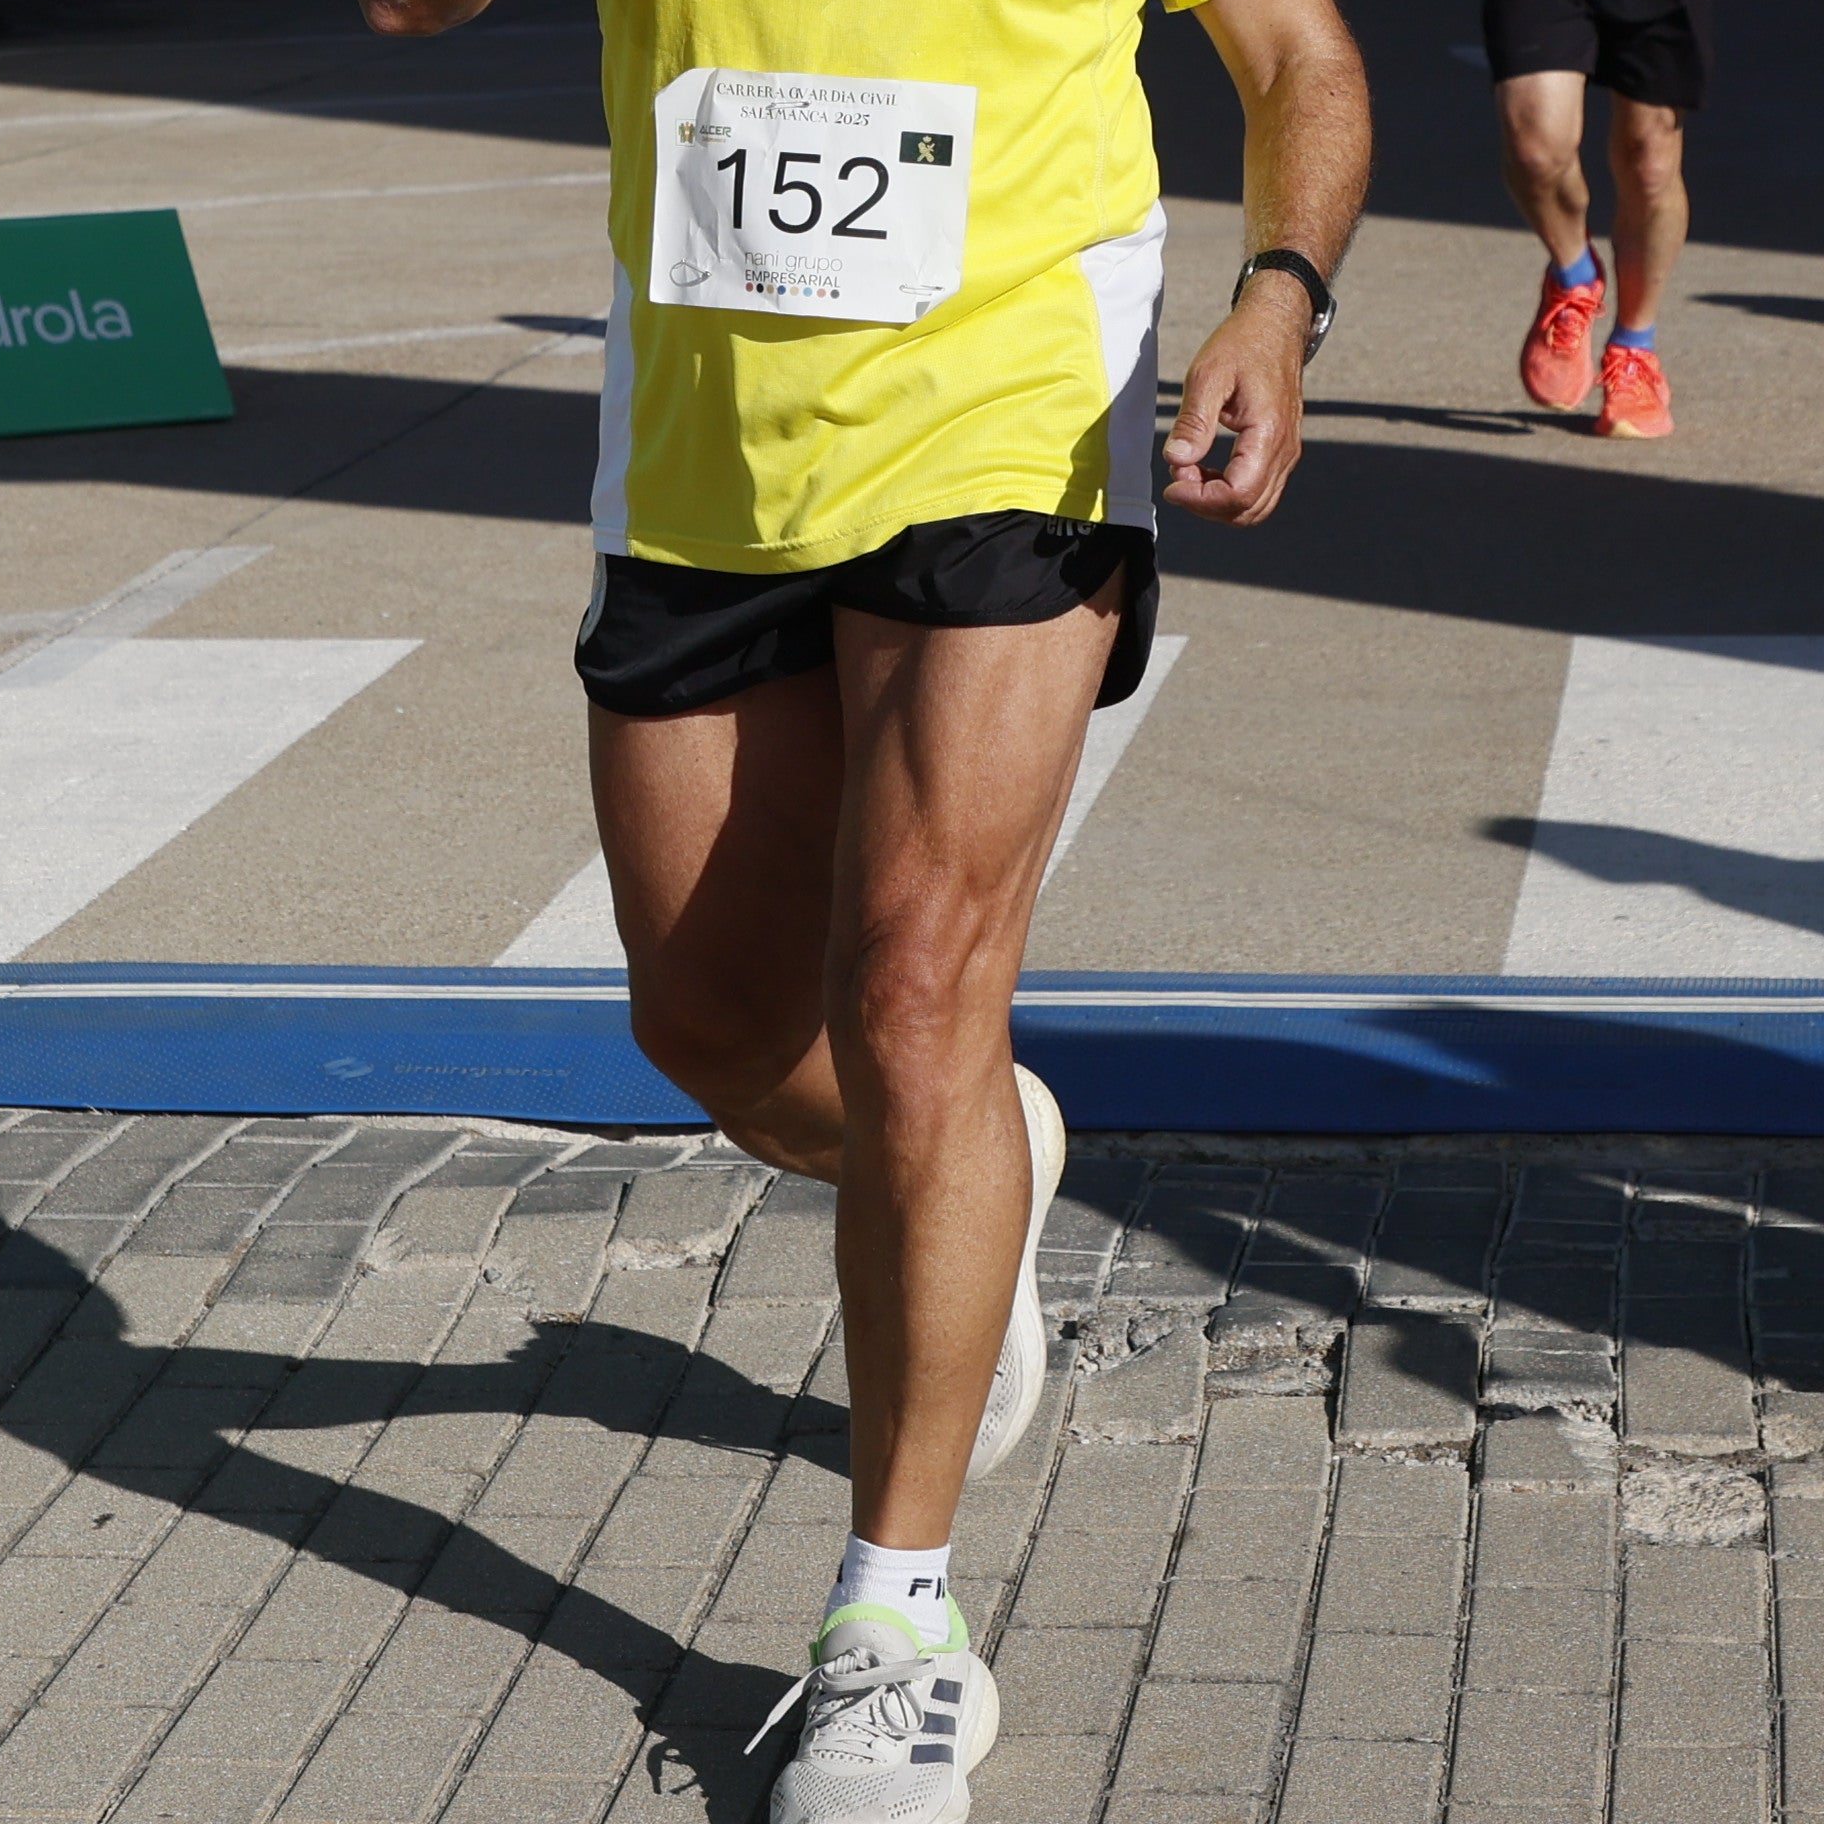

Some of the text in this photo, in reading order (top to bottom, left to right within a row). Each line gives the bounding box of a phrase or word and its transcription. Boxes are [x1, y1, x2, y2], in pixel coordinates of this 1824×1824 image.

[716, 82, 785, 100] CARRERA
[740, 106, 871, 127] SALAMANCA 2025
[717, 148, 890, 240] 152
[745, 249, 844, 273] nani grupo
[745, 269, 841, 287] EMPRESARIAL
